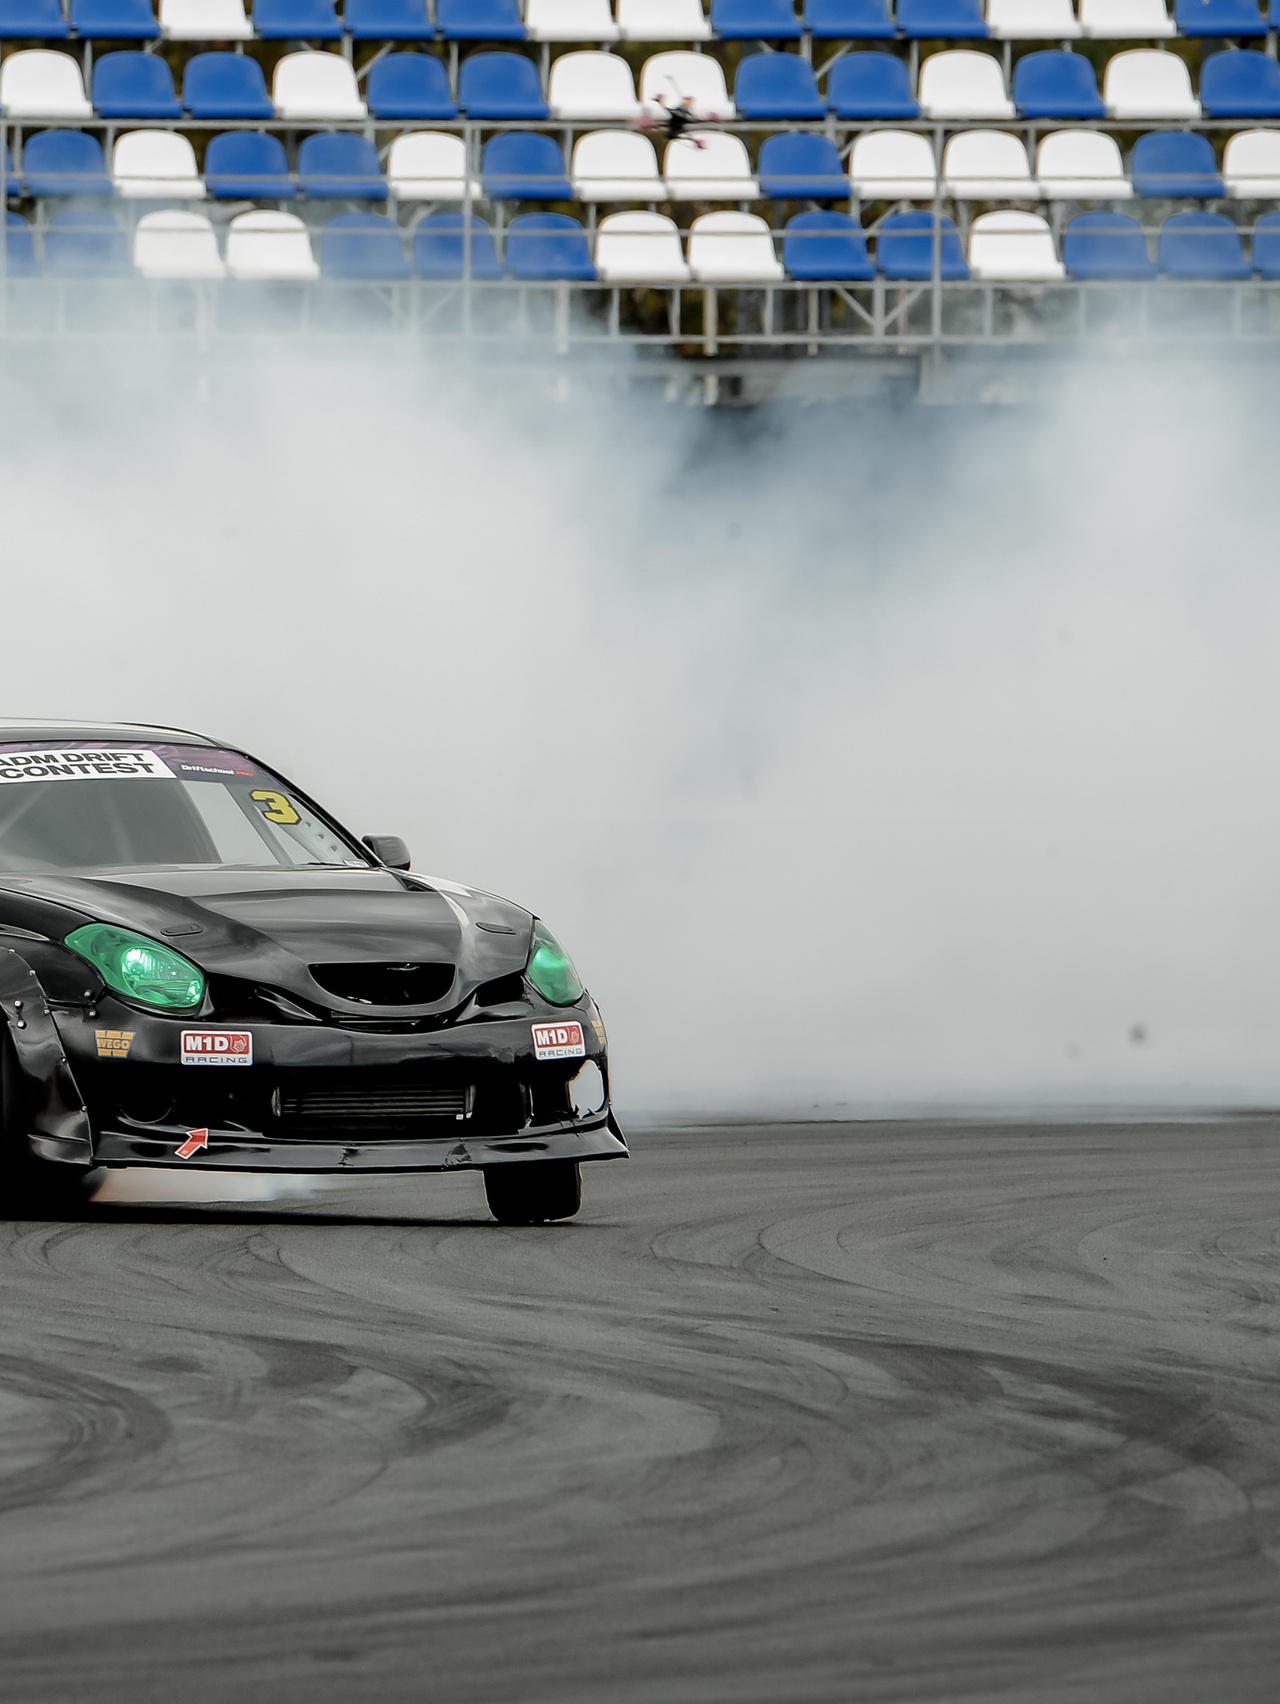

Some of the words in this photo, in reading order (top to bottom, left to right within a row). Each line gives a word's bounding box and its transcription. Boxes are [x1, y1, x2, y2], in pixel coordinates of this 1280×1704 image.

[61, 752, 145, 764] DRIFT
[181, 764, 235, 776] Driftschool
[250, 789, 302, 825] 3
[185, 1035, 229, 1051] M1D
[536, 1028, 568, 1046] M1D
[97, 1038, 131, 1050] WEGO
[538, 1048, 583, 1058] RACING
[185, 1056, 248, 1064] RACING
